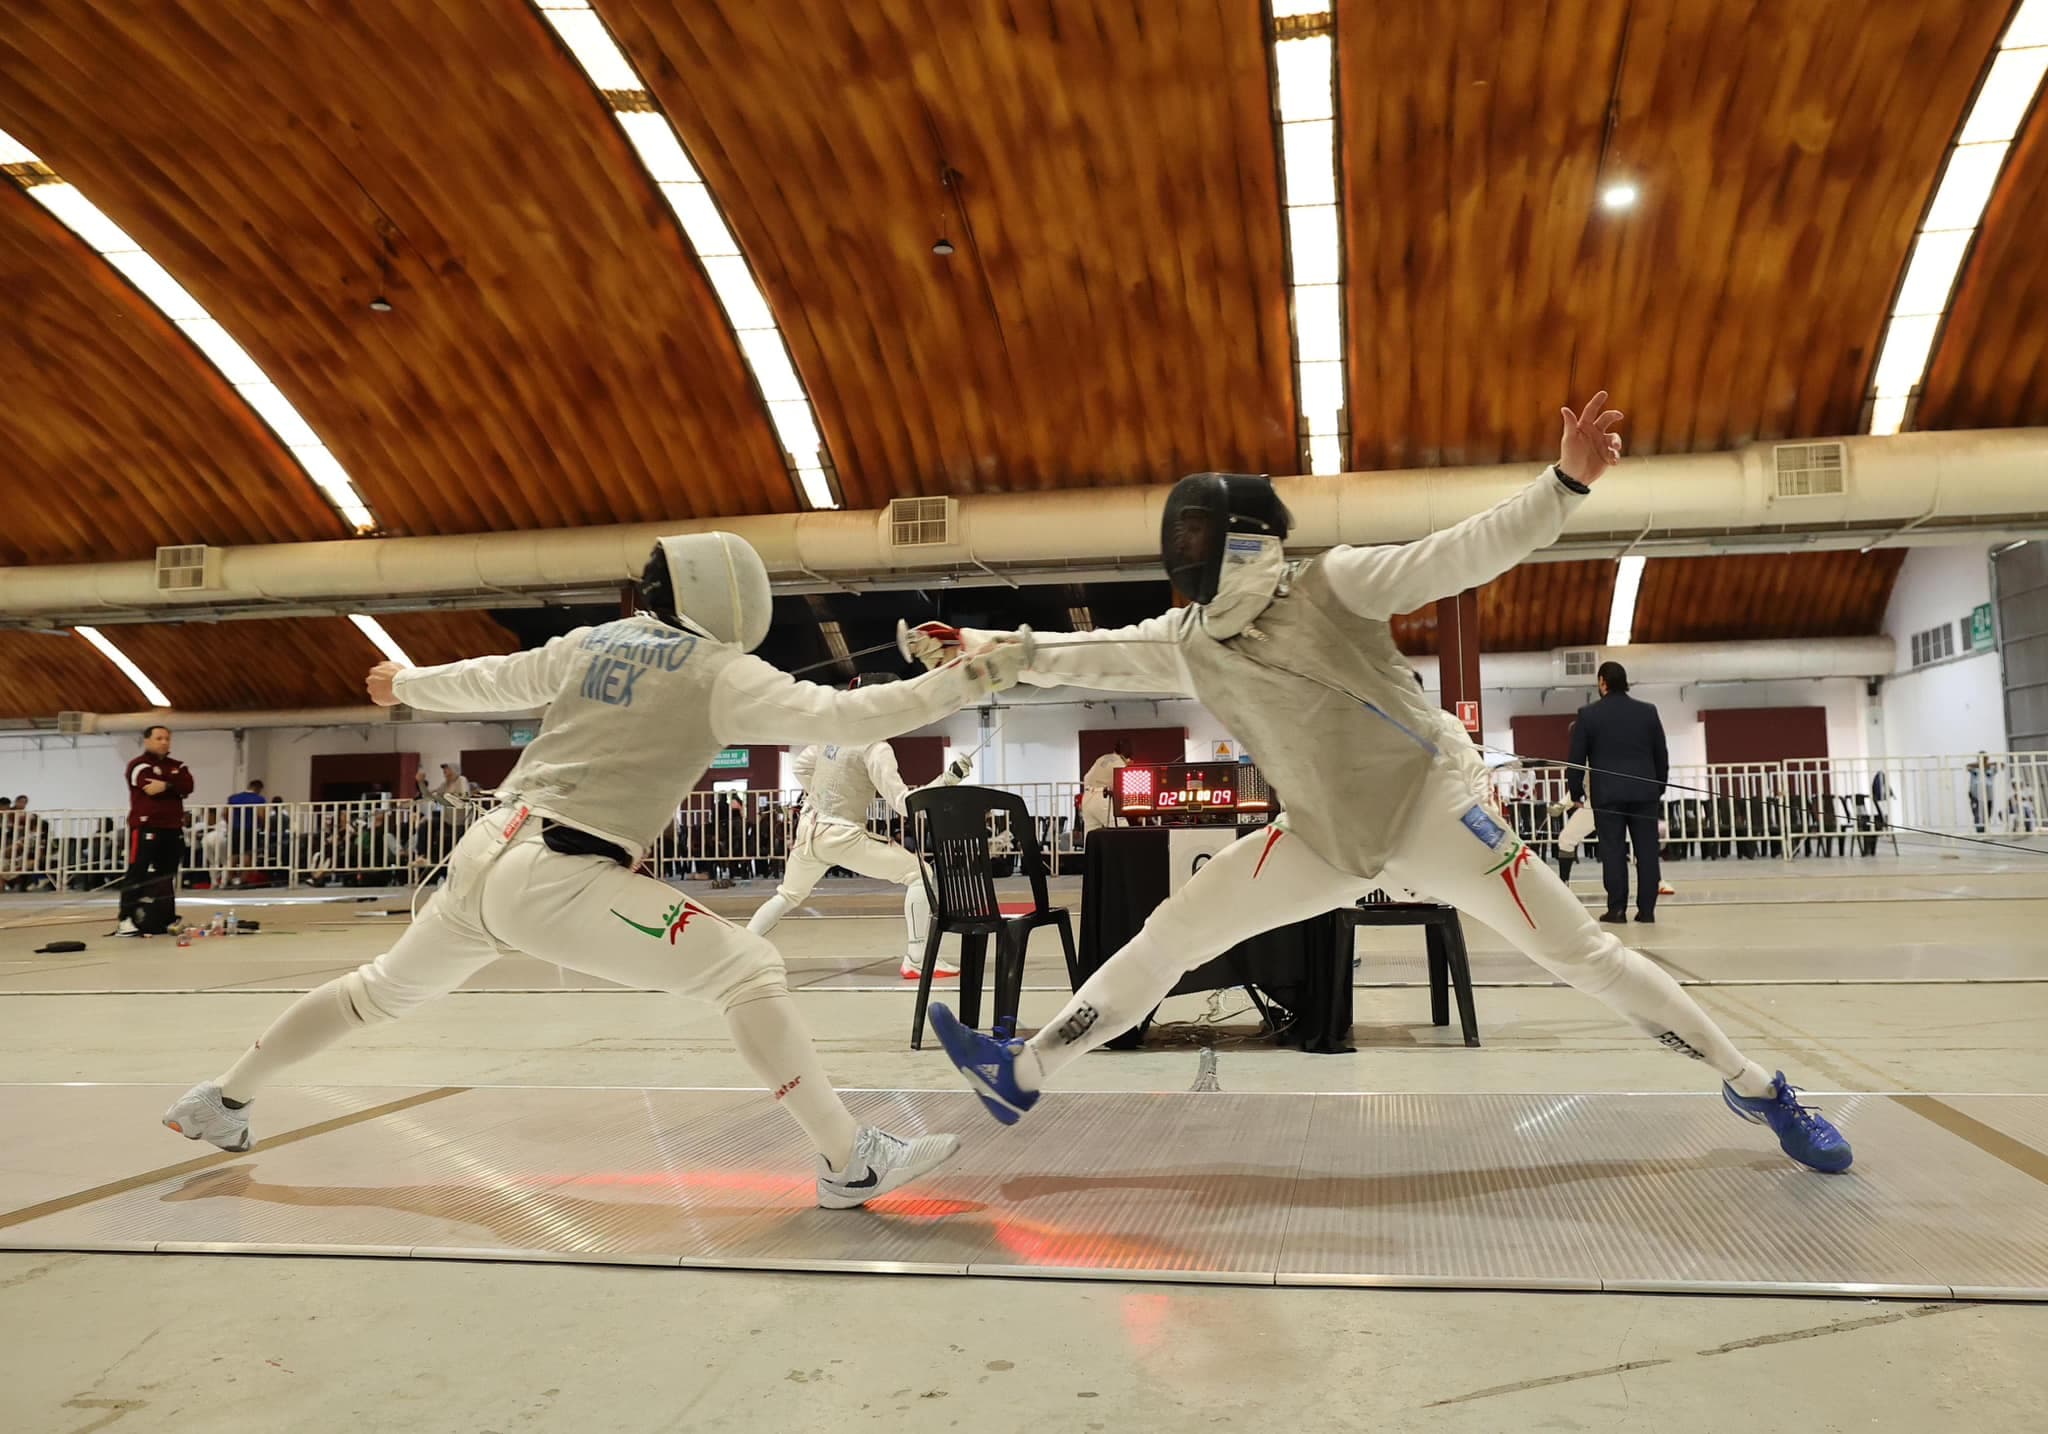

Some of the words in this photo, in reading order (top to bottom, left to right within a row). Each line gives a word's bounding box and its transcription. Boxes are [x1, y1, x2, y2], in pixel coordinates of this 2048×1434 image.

[580, 655, 647, 707] MEX
[1159, 791, 1177, 805] 02
[1212, 790, 1232, 804] 09
